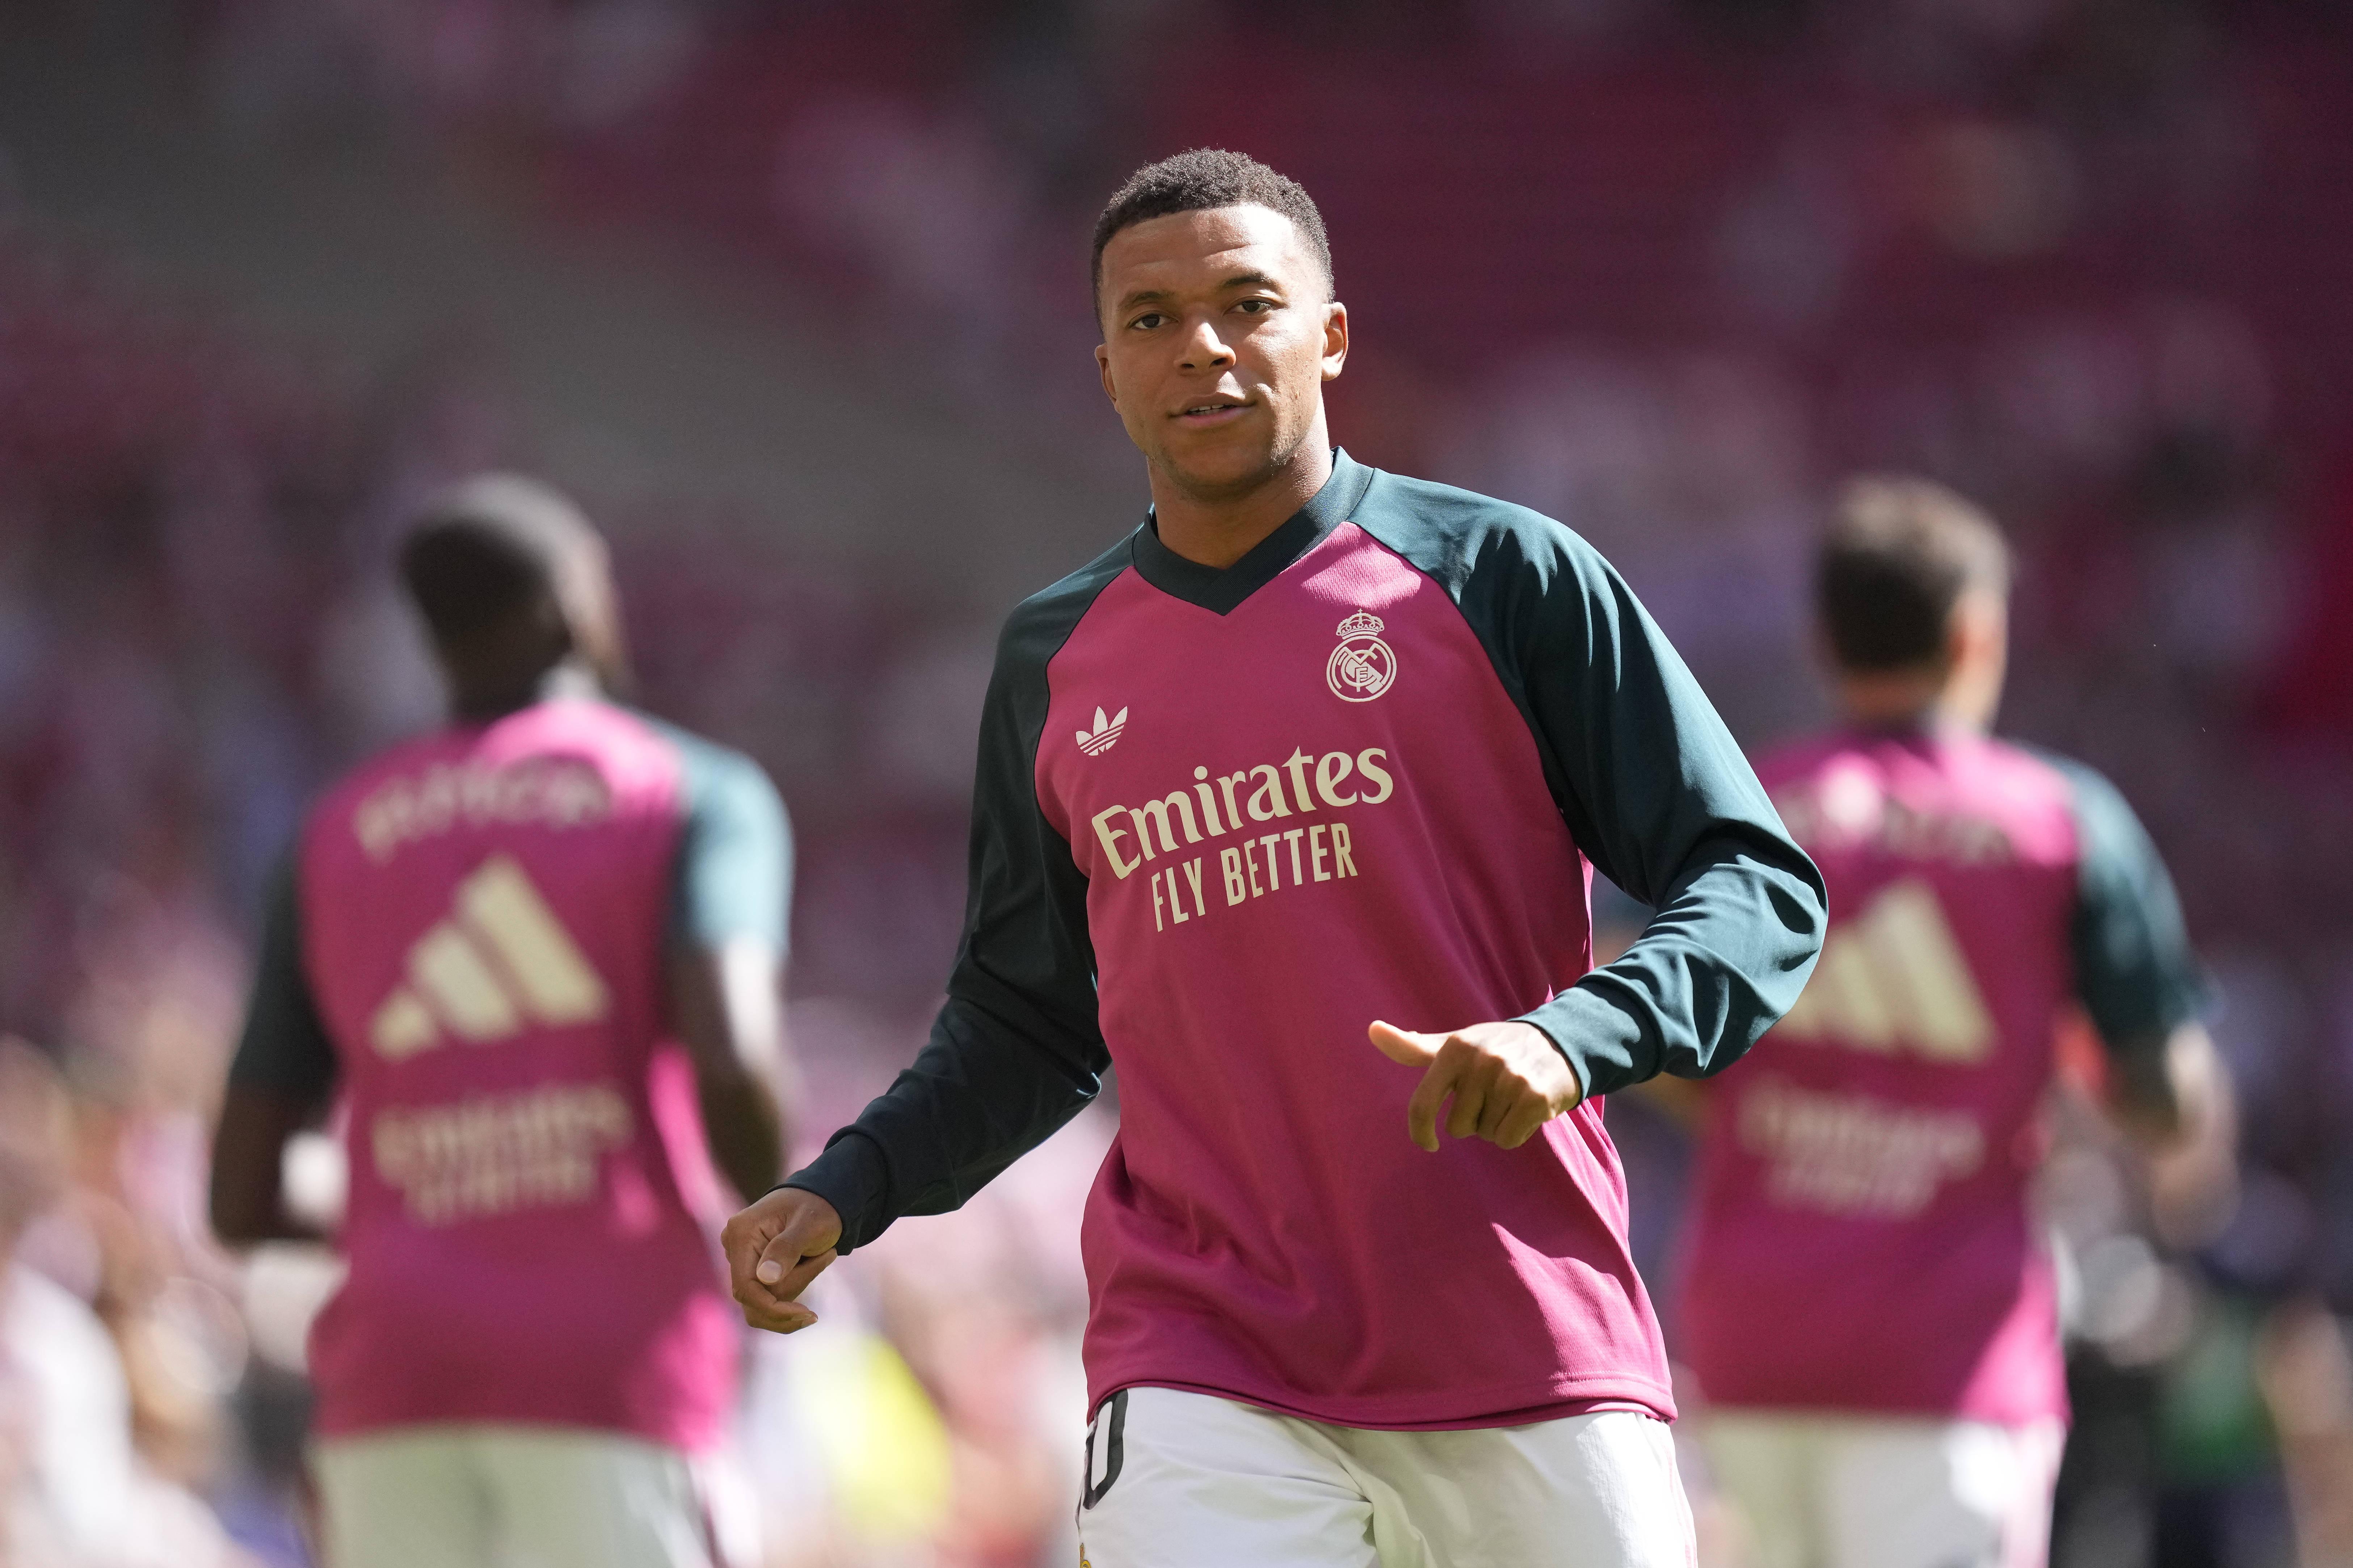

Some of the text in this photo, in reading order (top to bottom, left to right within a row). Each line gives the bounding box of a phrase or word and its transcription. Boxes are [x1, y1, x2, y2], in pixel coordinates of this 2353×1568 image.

[1092, 746, 1393, 880] Emirates
[1152, 823, 1358, 932] FLY BETTER
